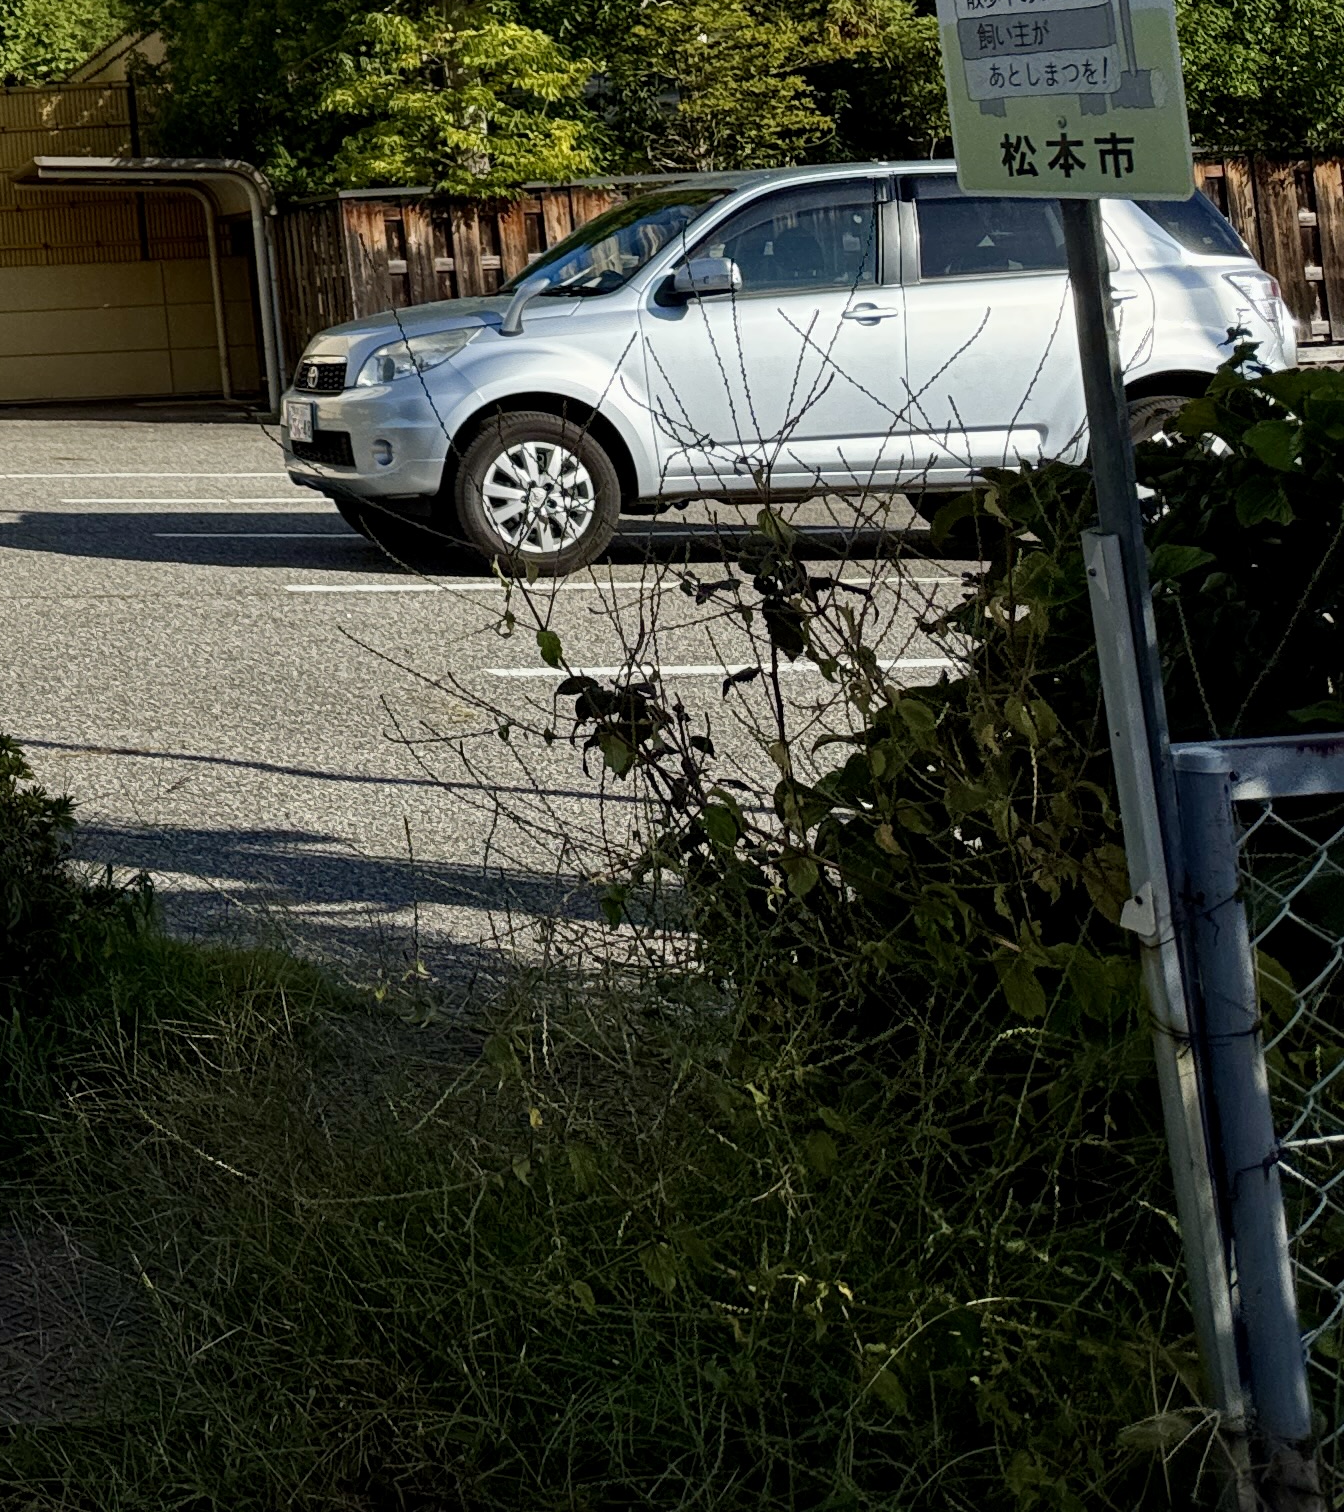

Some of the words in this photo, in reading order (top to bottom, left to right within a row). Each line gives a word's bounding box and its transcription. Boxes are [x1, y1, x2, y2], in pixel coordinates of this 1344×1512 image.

[976, 19, 1051, 51] 飼い主が
[999, 132, 1135, 179] 松本市
